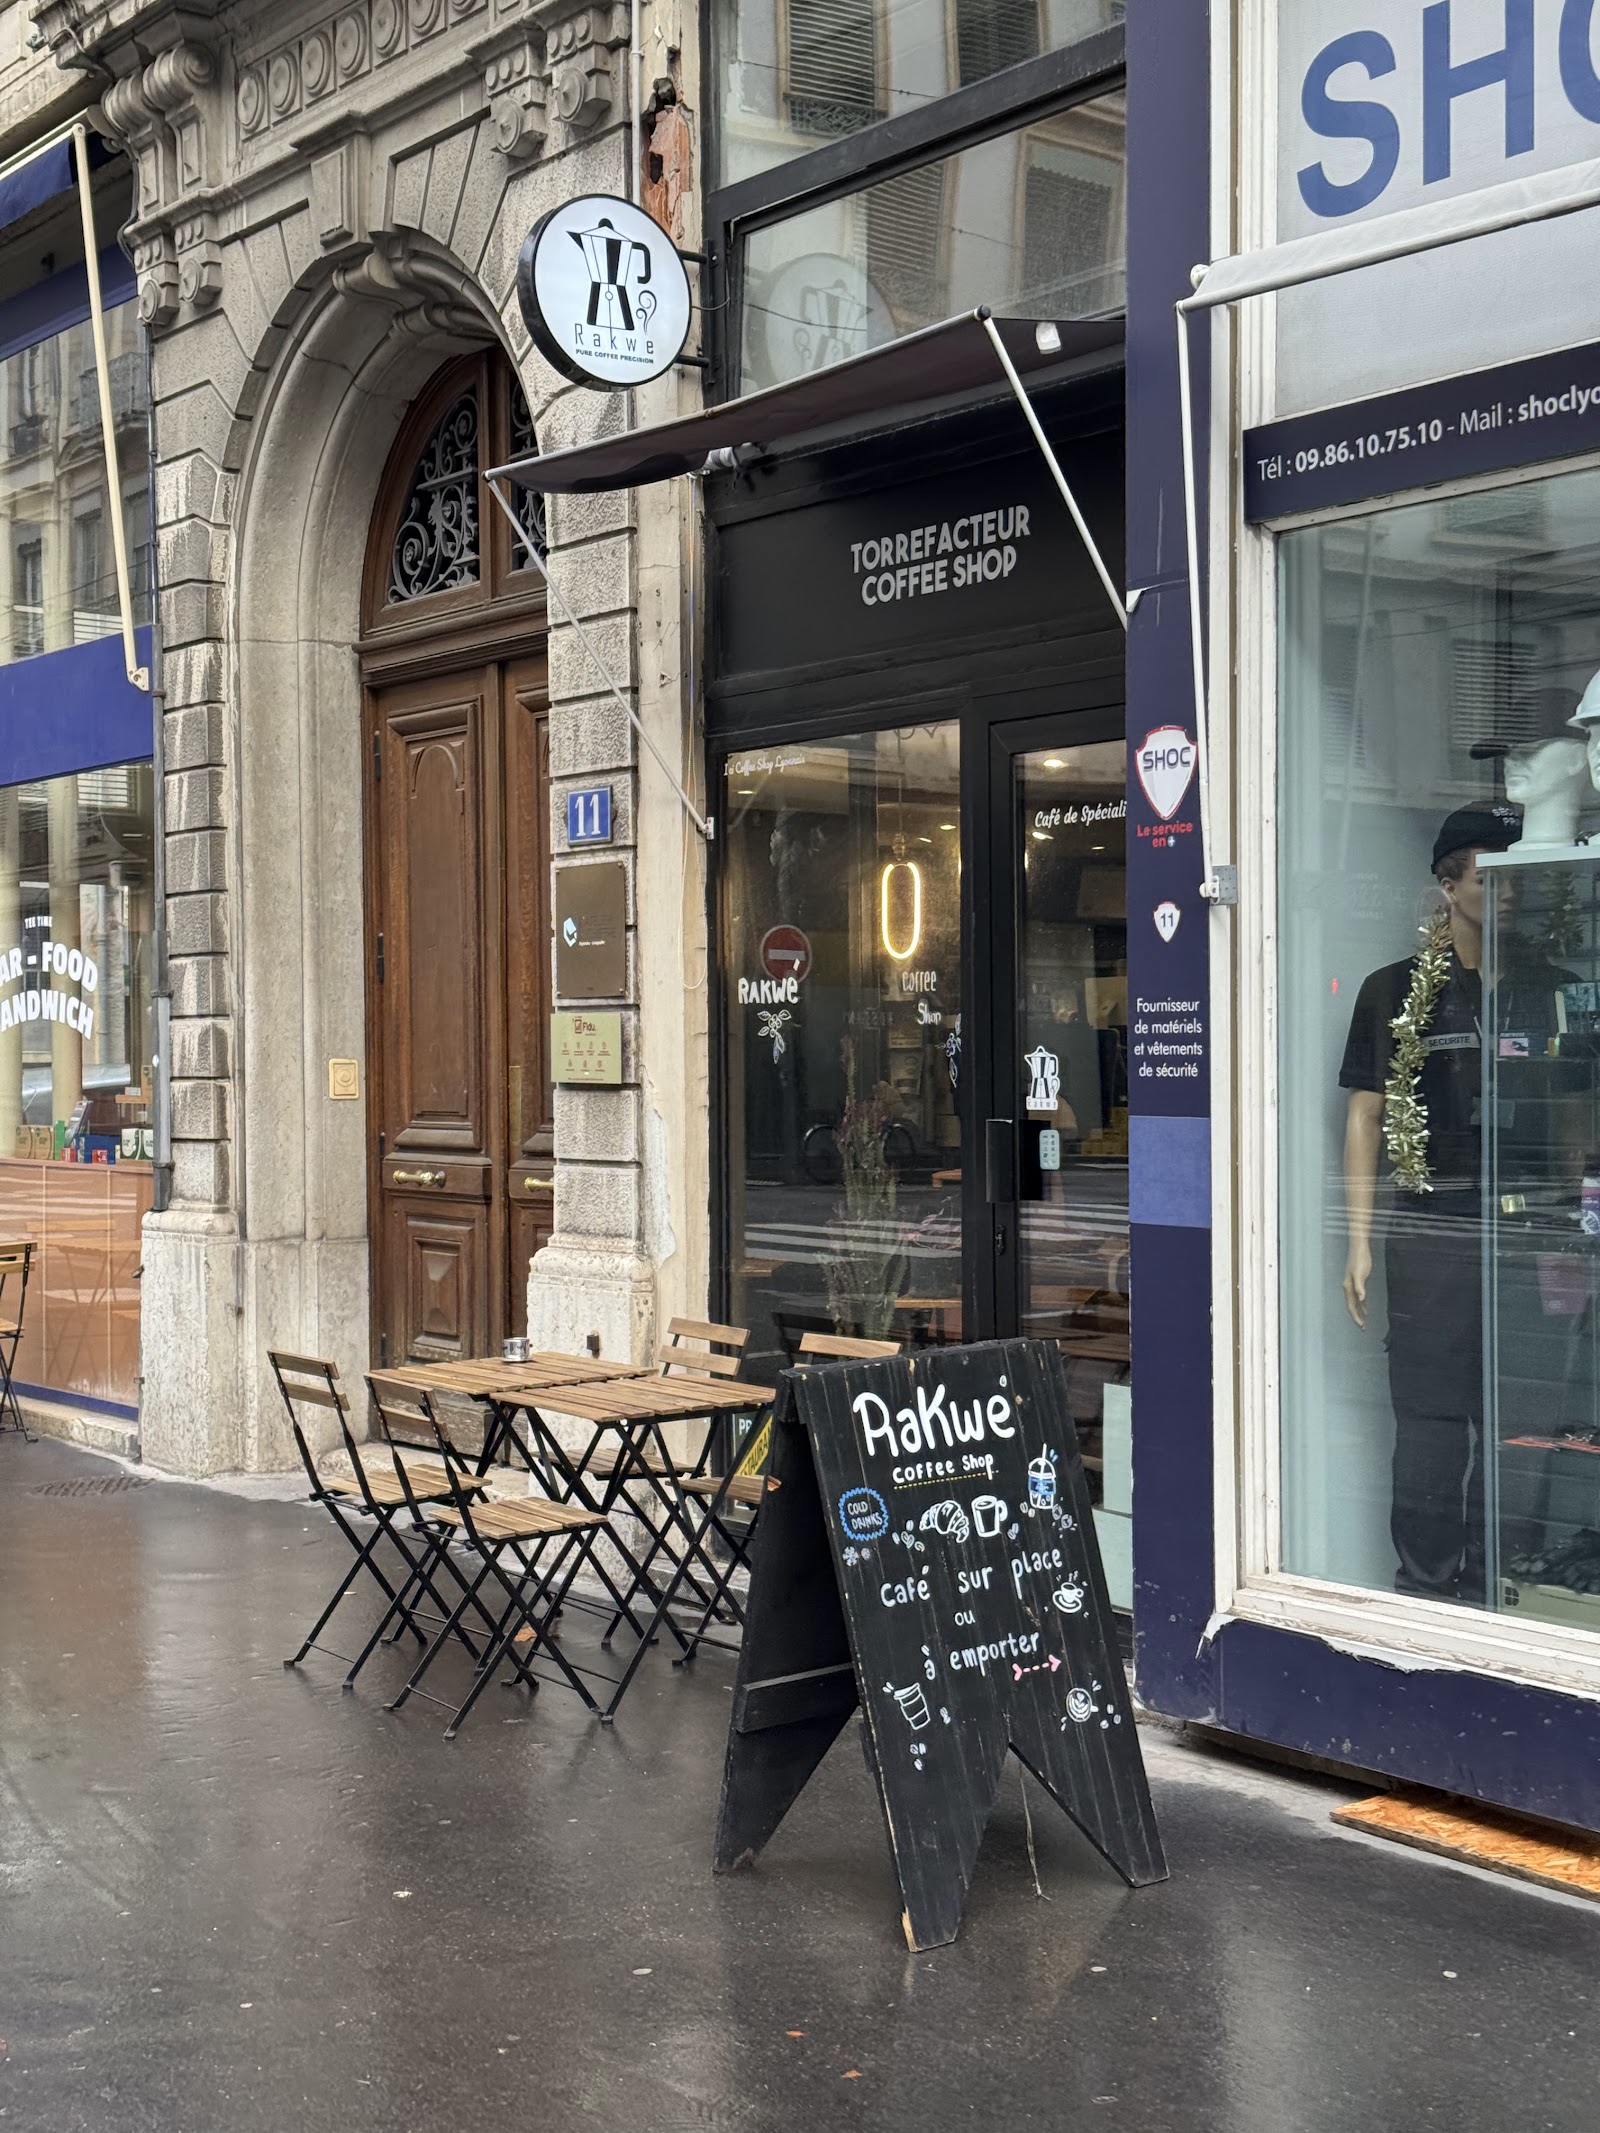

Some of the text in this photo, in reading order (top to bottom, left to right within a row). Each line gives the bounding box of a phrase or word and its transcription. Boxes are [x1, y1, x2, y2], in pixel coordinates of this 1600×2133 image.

[574, 323, 654, 355] Rakwe
[575, 348, 654, 364] PURE COFFEE PRECISION
[1295, 418, 1443, 473] 09.86.10.75.10
[1460, 402, 1502, 435] Mail
[850, 505, 1031, 574] TORREFACTEUR
[861, 545, 1017, 606] COFFEE SHOP
[1142, 746, 1191, 771] SHOC
[574, 793, 601, 837] 11
[1034, 799, 1128, 829] Café de Spéciali
[1136, 820, 1194, 837] Le service
[1160, 912, 1175, 928] 11
[42, 941, 98, 993] FOOD
[0, 988, 94, 1040] ANDWICH
[917, 1002, 942, 1026] Shop
[1136, 997, 1200, 1013] Fournisseur
[1134, 1017, 1203, 1034] de matériels
[1134, 1041, 1203, 1057] et vêtements
[1138, 1061, 1199, 1078] de sécurité
[847, 1500, 869, 1516] COLD
[851, 1511, 883, 1531] DRINKS
[957, 1566, 993, 1594] sur
[1011, 1548, 1063, 1600] place
[954, 1610, 976, 1626] ou
[921, 1631, 1040, 1681] à emporter
